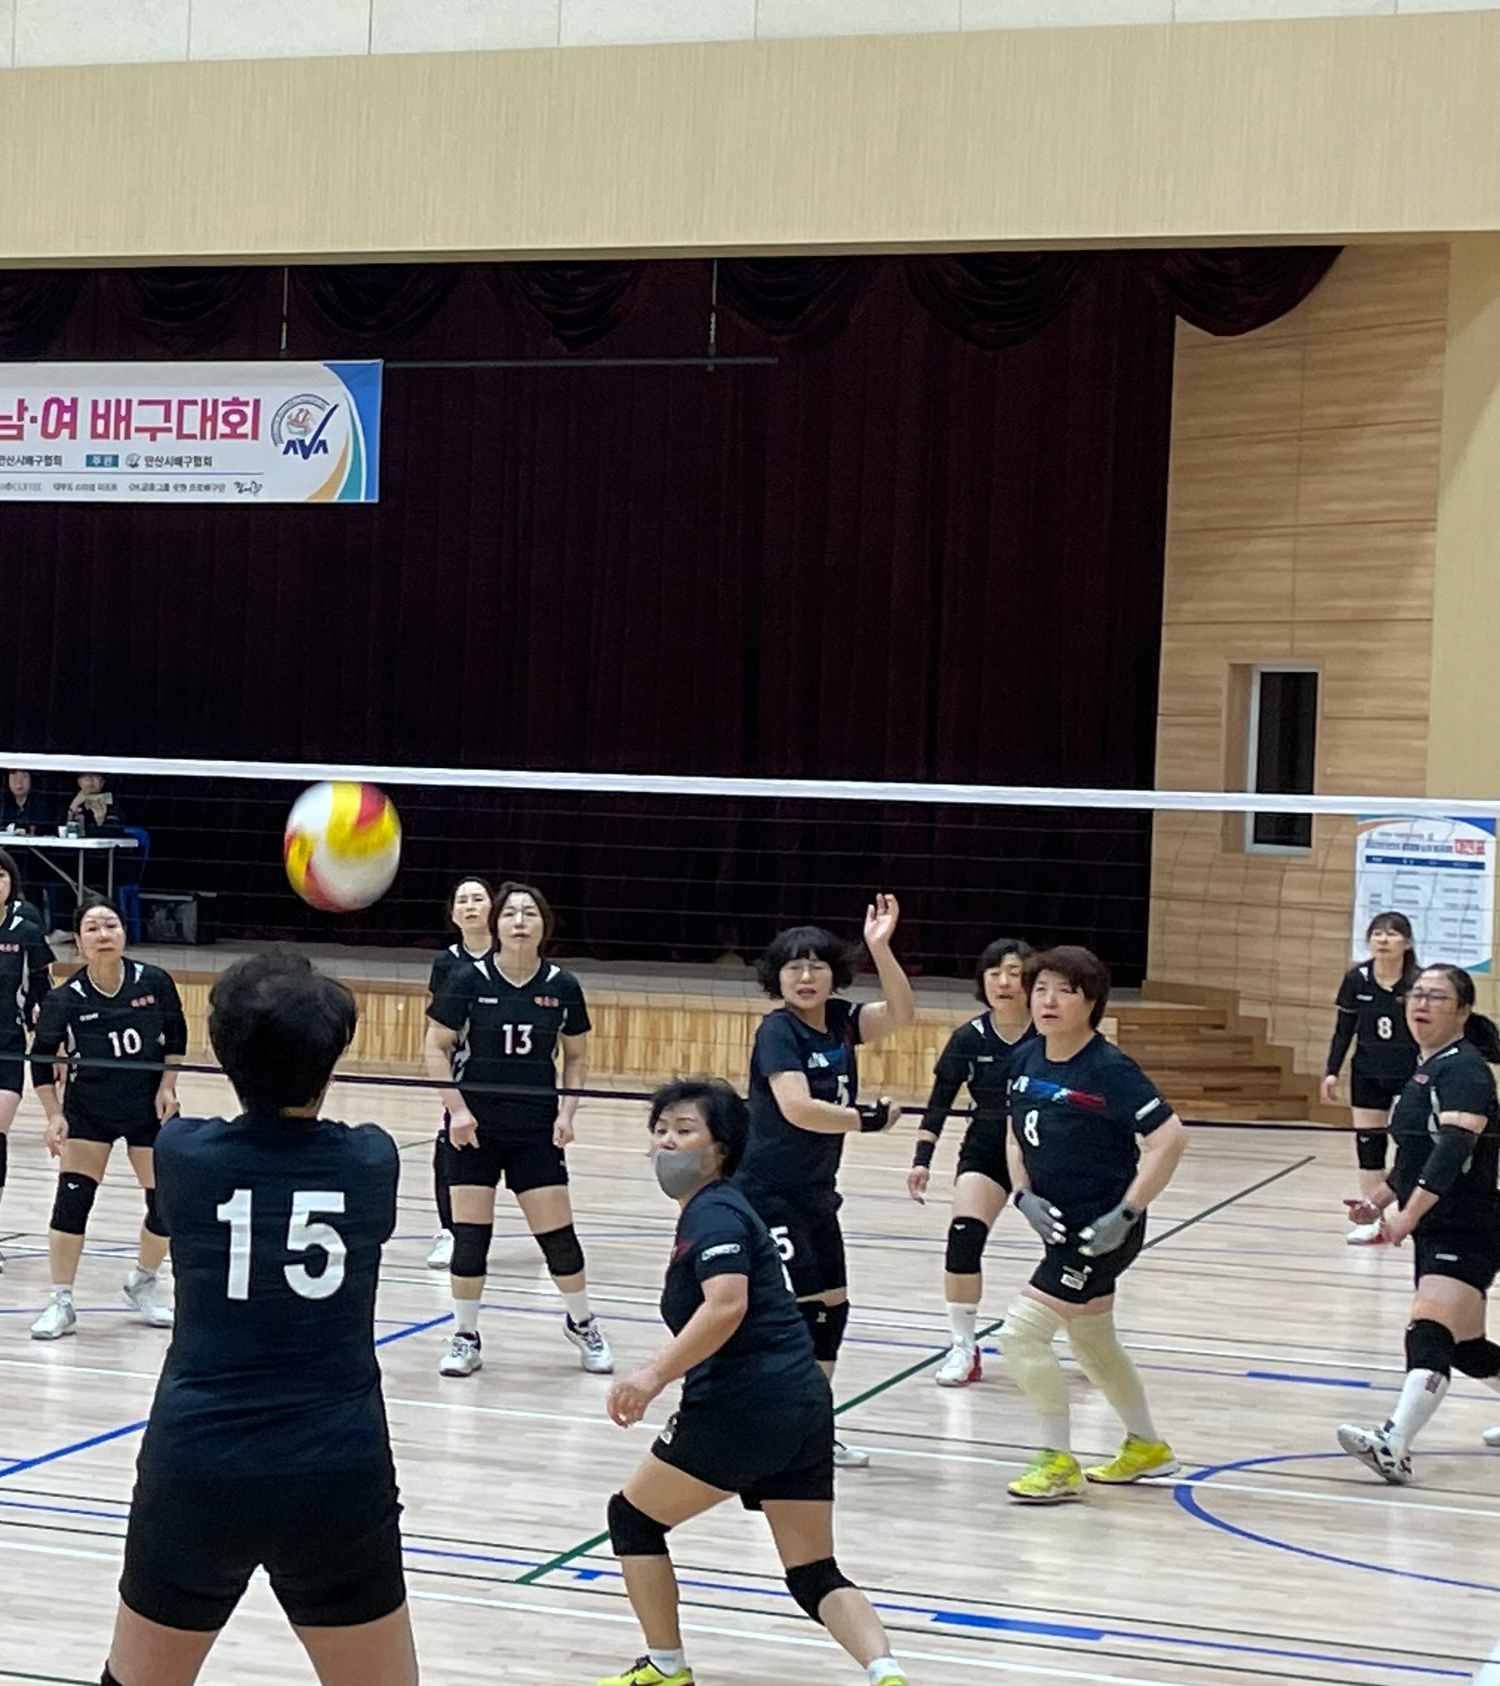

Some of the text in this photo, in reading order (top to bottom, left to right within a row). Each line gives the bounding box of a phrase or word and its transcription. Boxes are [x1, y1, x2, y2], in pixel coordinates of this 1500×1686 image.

[90, 397, 262, 442] 배구대회
[108, 1028, 141, 1057] 10
[502, 1023, 534, 1055] 13
[1377, 1016, 1393, 1040] 8
[1024, 1109, 1040, 1147] 8
[217, 1188, 347, 1300] 15
[769, 1226, 795, 1261] 5
